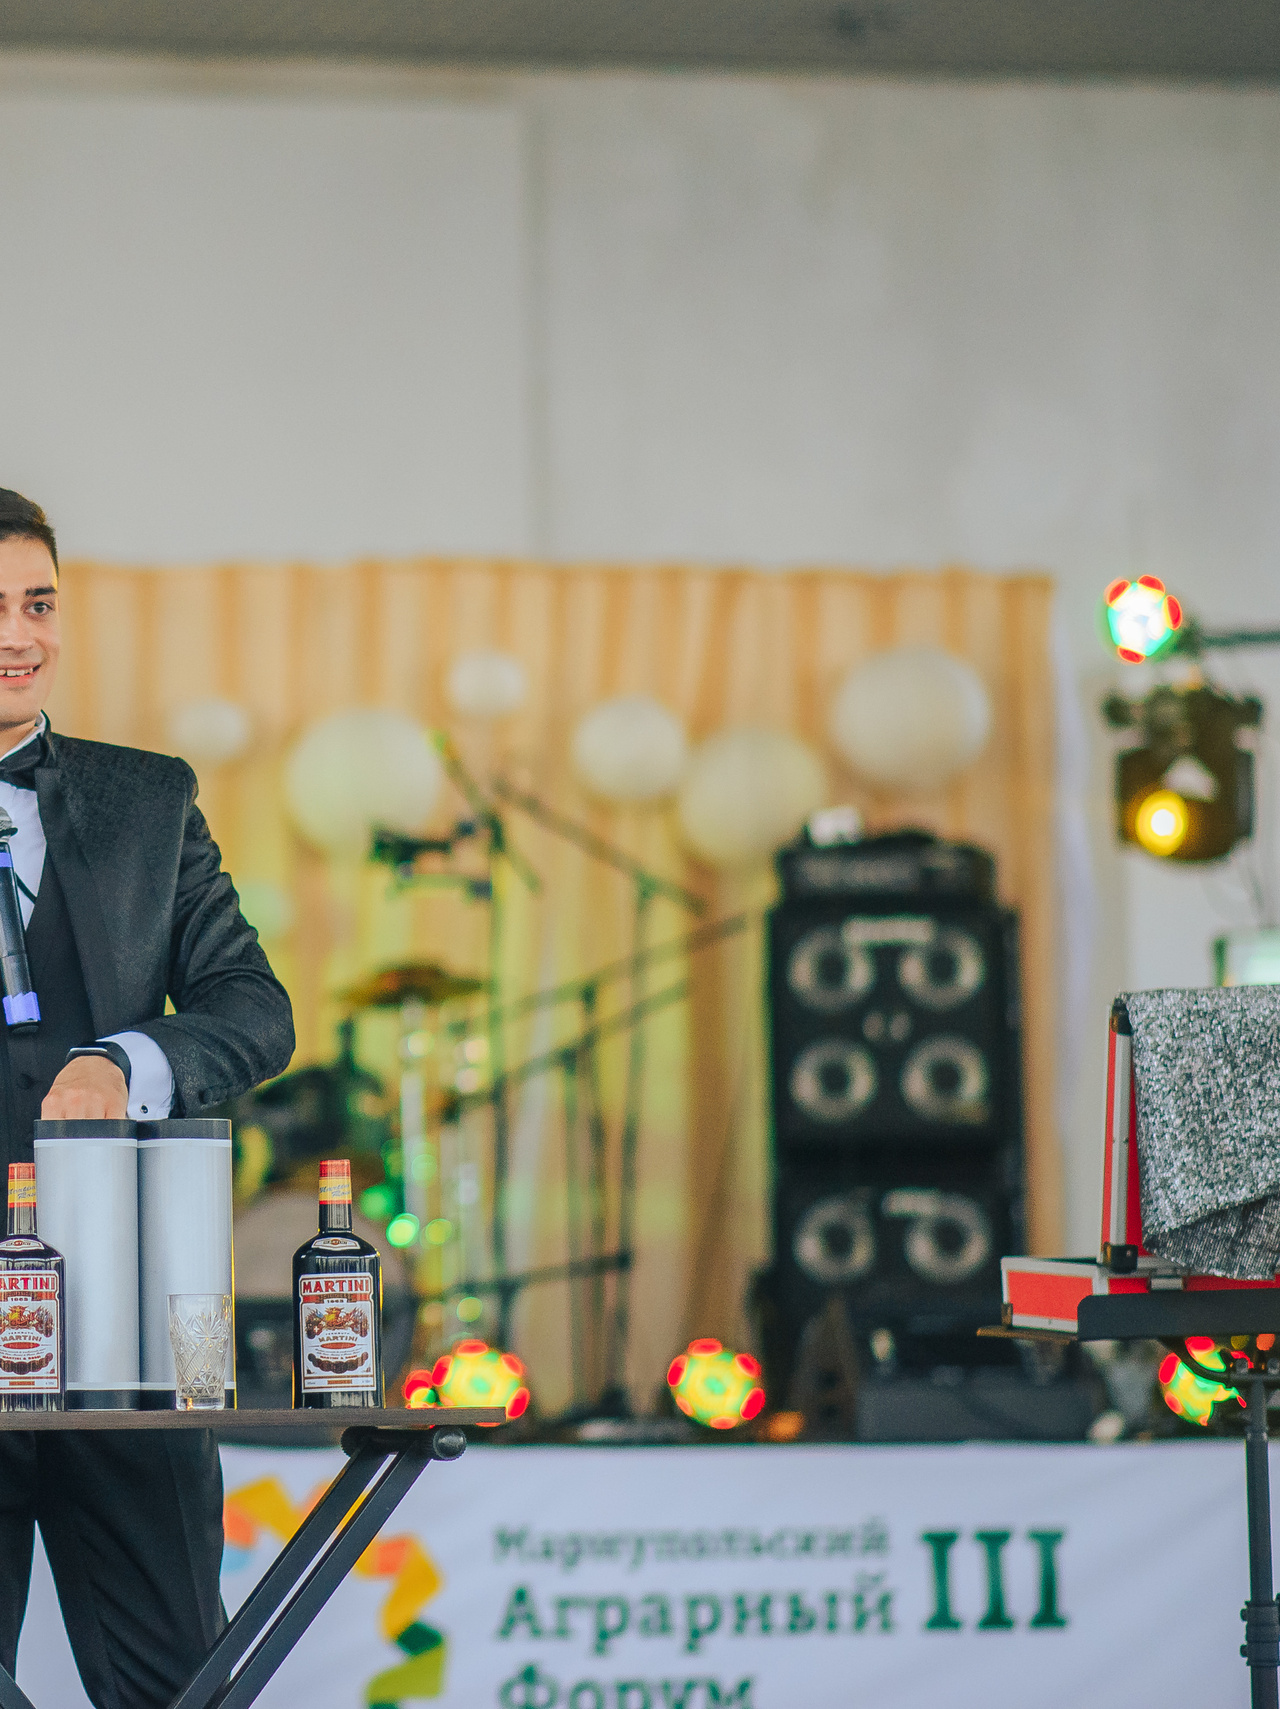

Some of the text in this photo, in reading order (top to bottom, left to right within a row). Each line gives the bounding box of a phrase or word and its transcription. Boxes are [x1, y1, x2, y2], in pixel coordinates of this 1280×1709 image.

[302, 1280, 369, 1293] MARTINI
[318, 1335, 358, 1343] MARTINI
[921, 1530, 1070, 1631] III
[497, 1572, 893, 1656] Аграрный
[498, 1663, 755, 1709] Форум
